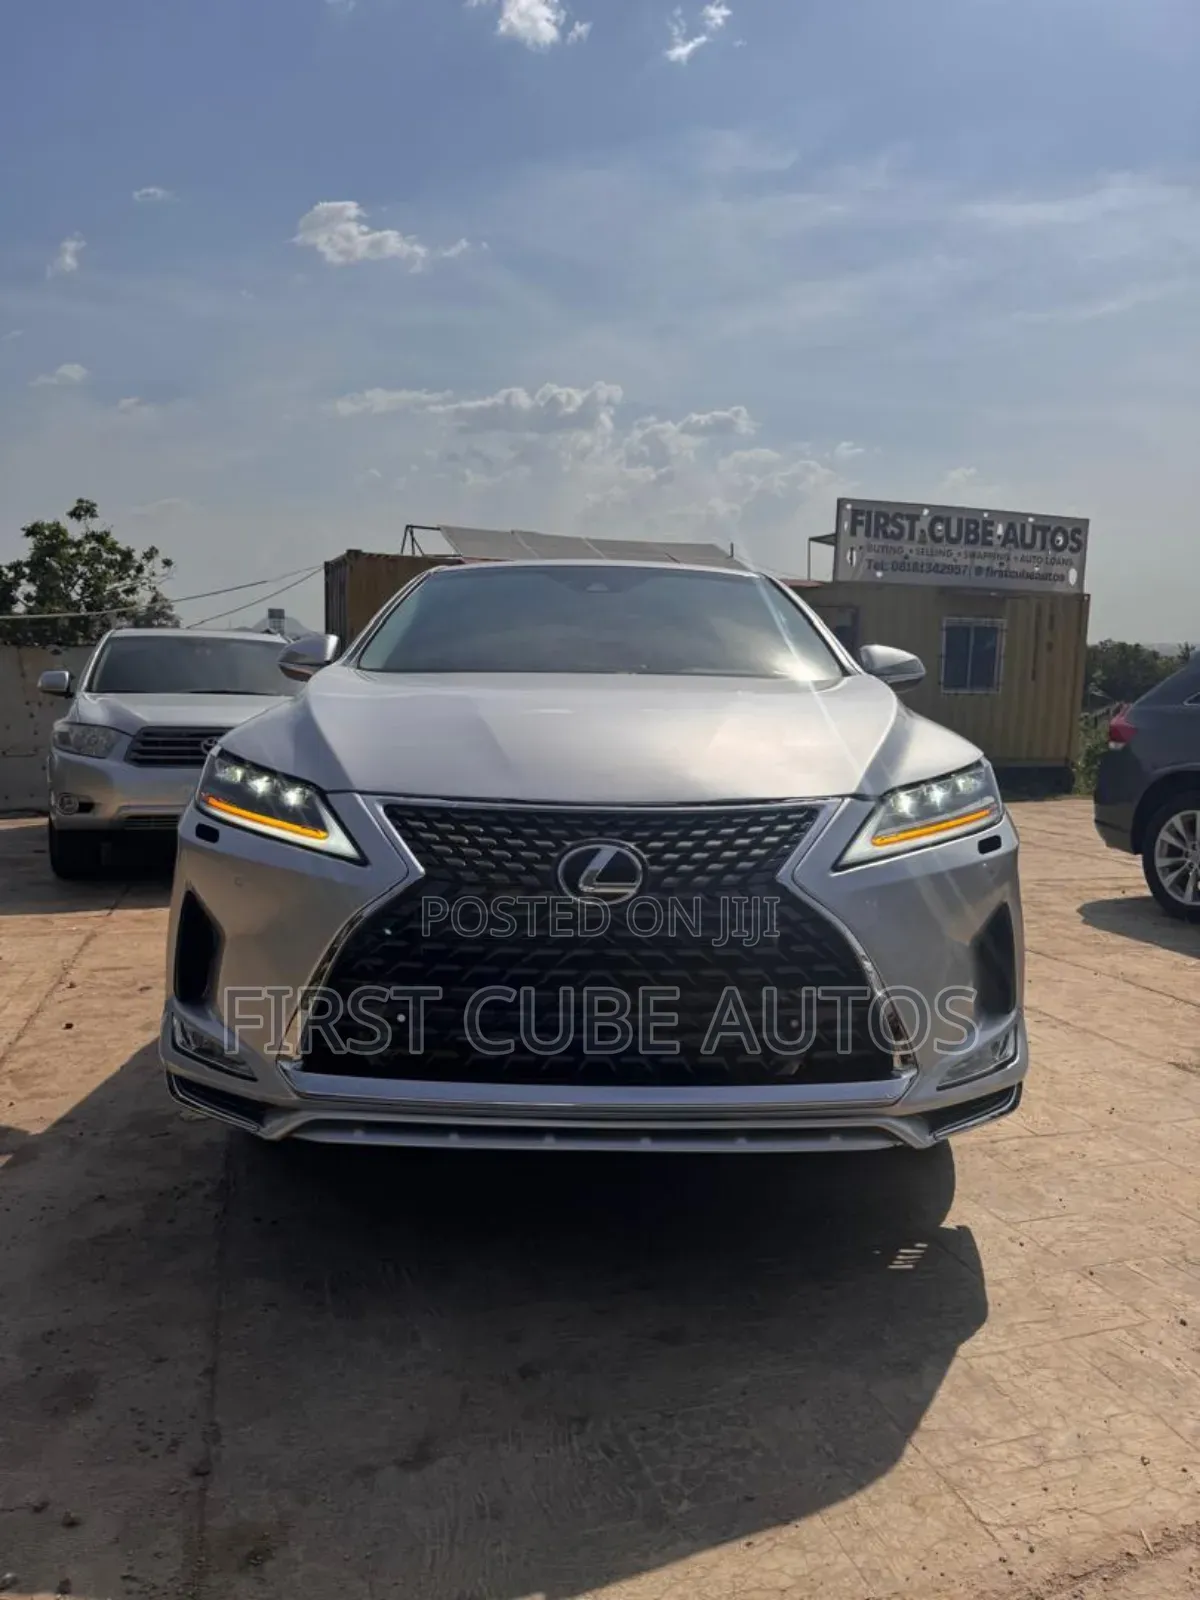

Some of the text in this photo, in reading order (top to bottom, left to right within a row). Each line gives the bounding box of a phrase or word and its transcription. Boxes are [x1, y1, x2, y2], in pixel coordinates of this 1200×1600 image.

[850, 508, 1082, 554] FIRST CUBE AUTOS
[915, 547, 953, 558] SELLING
[1020, 554, 1044, 565] AUTO
